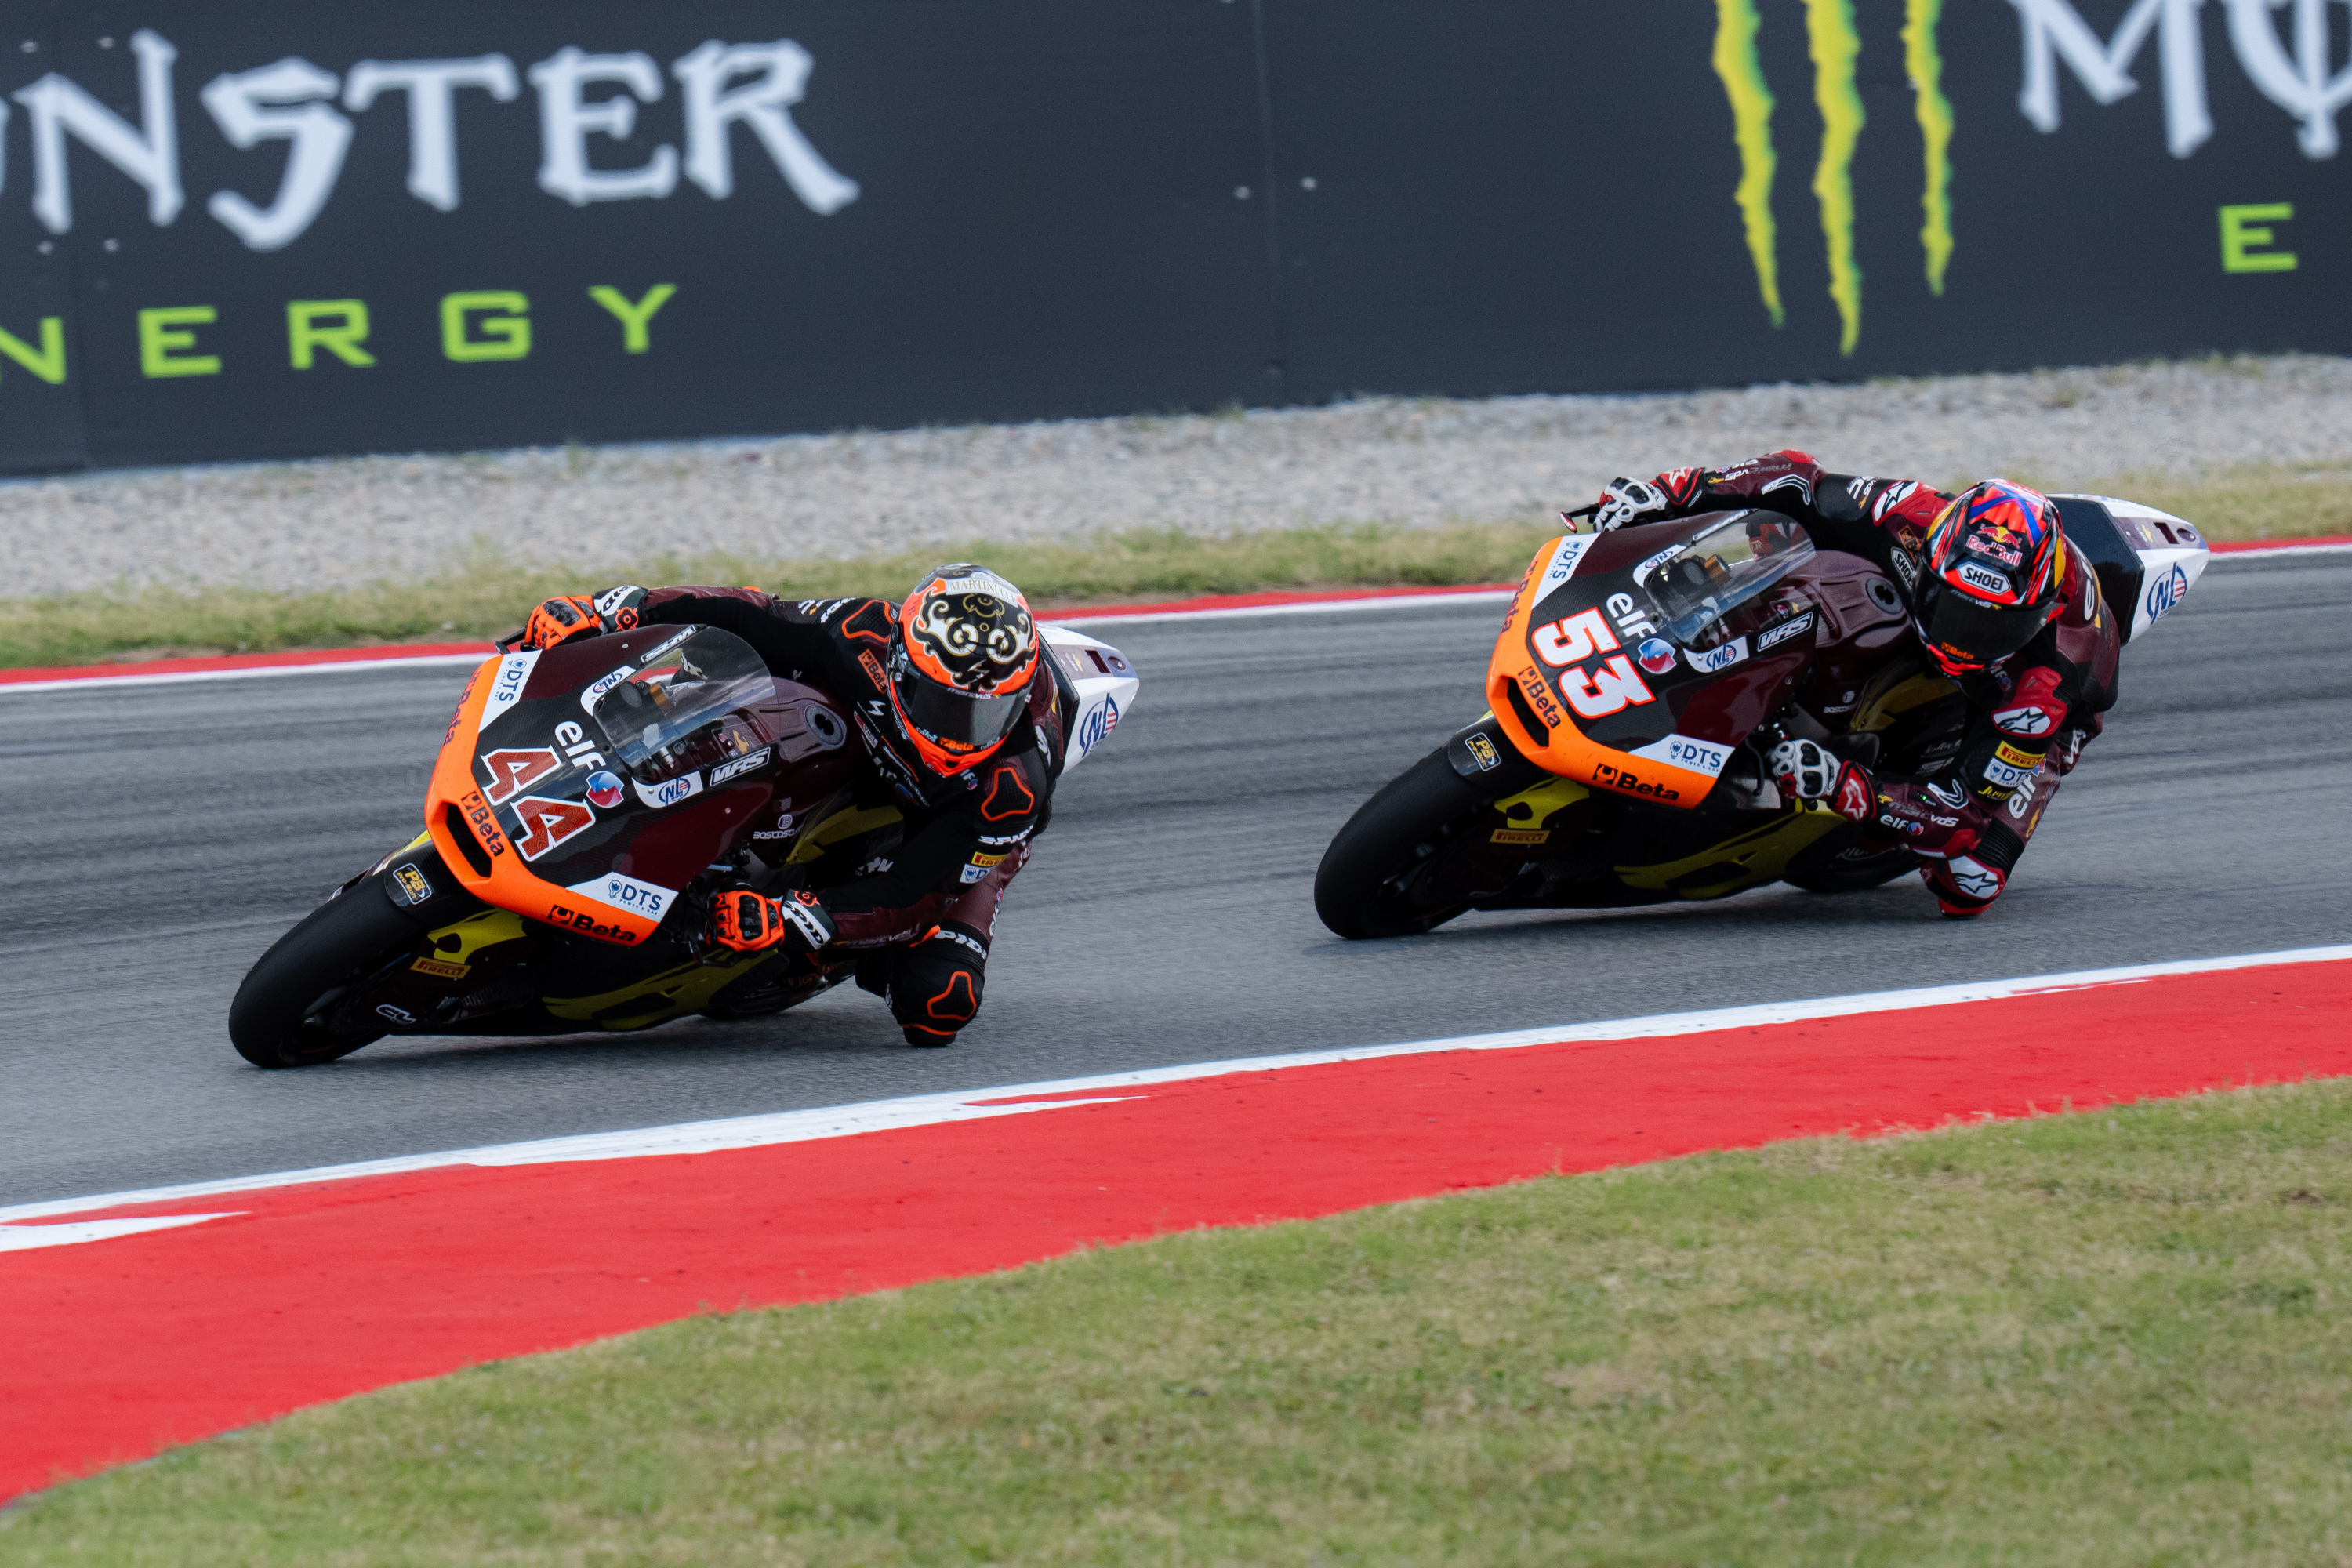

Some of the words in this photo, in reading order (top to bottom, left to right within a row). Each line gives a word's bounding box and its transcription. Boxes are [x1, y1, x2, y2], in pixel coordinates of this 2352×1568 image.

[0, 29, 859, 252] NSTER
[1552, 550, 1578, 579] DTS
[1966, 534, 1996, 555] Red
[1993, 545, 2024, 567] Bull
[949, 579, 1015, 603] MARTINUCCI
[1965, 567, 2004, 591] SHOEI
[1606, 592, 1657, 639] elf
[1761, 613, 1813, 648] WRS
[868, 663, 887, 693] Beta
[1531, 606, 1657, 720] 53
[498, 670, 524, 702] DTS
[1526, 680, 1562, 729] Beta
[554, 720, 607, 771] elf
[1475, 739, 1495, 759] PB
[1682, 744, 1722, 768] DTS
[713, 750, 768, 783] WRS
[1616, 771, 1679, 801] Beta
[480, 745, 596, 862] 44
[470, 801, 505, 858] Beta
[1879, 814, 1909, 829] elf
[1495, 831, 1544, 843] PIRELLI
[405, 870, 426, 891] PB
[621, 883, 662, 911] DTS
[572, 916, 637, 942] Beta
[418, 959, 468, 978] PIRELLI
